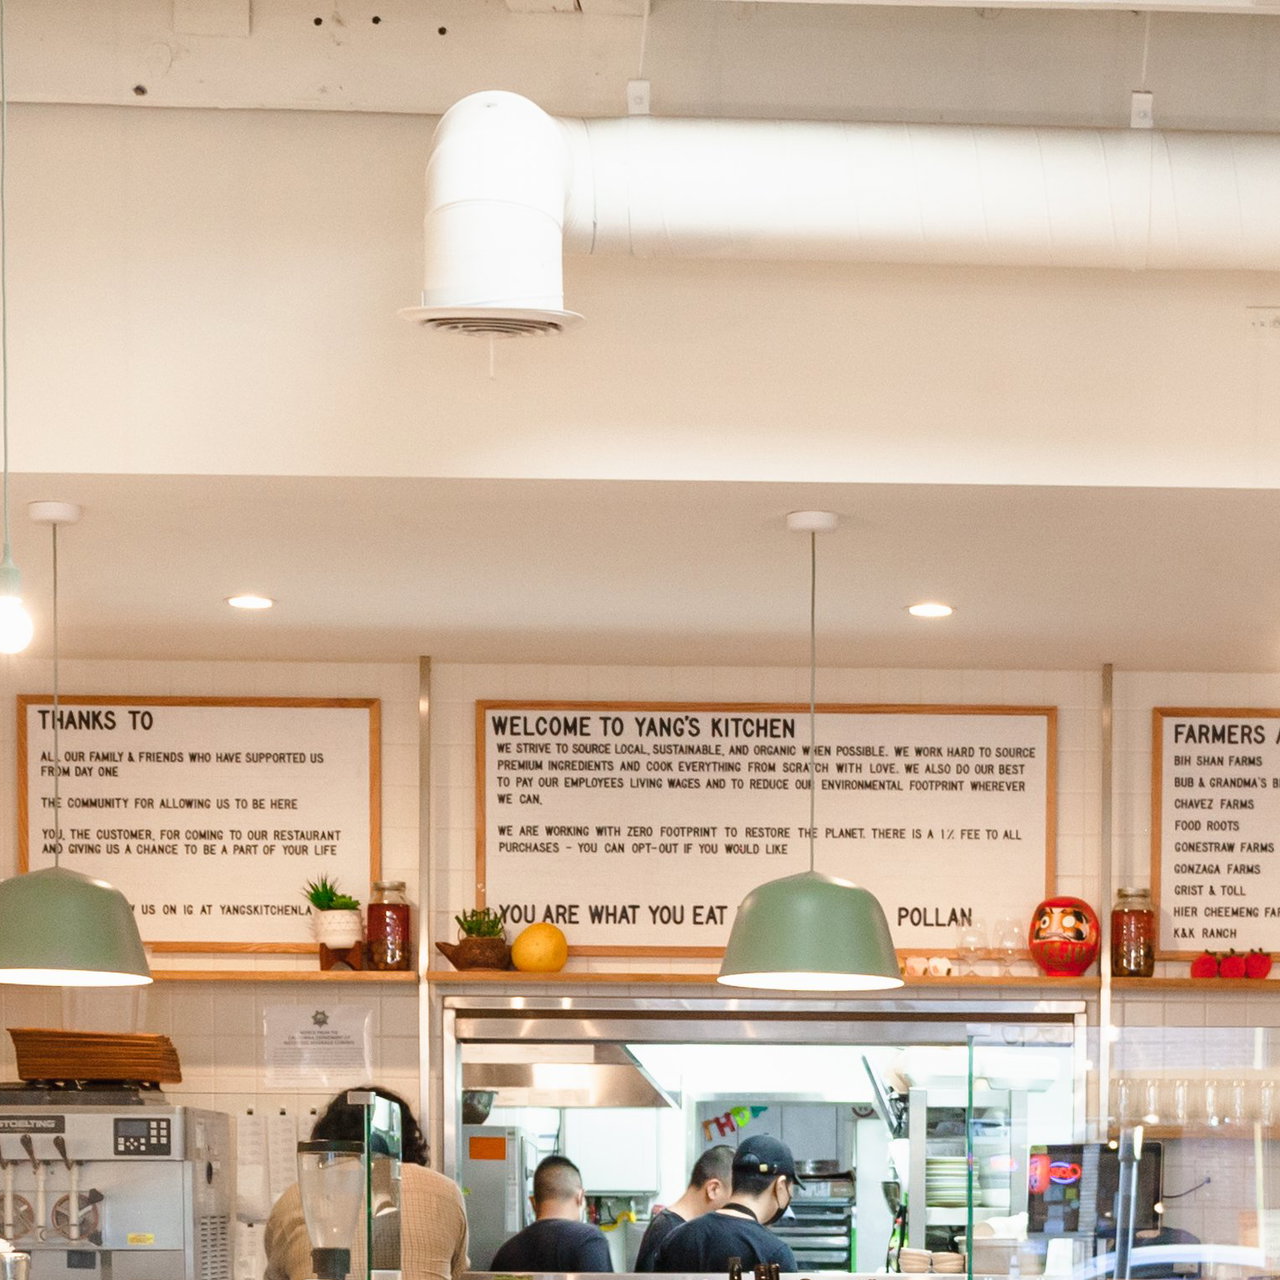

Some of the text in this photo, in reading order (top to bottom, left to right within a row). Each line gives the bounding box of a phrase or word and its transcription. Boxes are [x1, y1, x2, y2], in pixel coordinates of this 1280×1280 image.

[38, 710, 153, 730] THANKS TO
[492, 715, 794, 738] WELCOME TO YANG'S KITCHEN
[1174, 724, 1265, 744] FARMERS
[516, 742, 1035, 758] STRIVE SOURCE LOCAL, SUSTAINABLE, AND ORGANIC POSSIBLE. WORK HARD SOURCE
[64, 751, 306, 763] OUR FAMILY FRIENDS WHO HAVE SUPPORTED
[1174, 755, 1262, 766] BIH SHAN FARMS
[74, 766, 118, 777] DAY ONE
[497, 759, 1025, 775] PREMIUM INGREDIENTS AND COOK EVERYTHING FROM WITH LOVE. ALSO OUR BEST
[516, 776, 1025, 791] PAY OUR EMPLOYEES LIVING WAGES AND REDUCE ENVIRONMENTAL FOOTPRINT WHEREVER
[1174, 776, 1194, 787] BUB
[1209, 777, 1267, 788] GRANDMA'S
[67, 797, 297, 809] COMMUNITY FOR ALLOWING HERE
[1174, 798, 1254, 809] CHAVEZ FARMS
[1174, 819, 1239, 831] FOOD ROOTS
[70, 828, 341, 841] THE CUSTOMER, FOR COMING OUR RESTAURANT
[519, 825, 1021, 840] ARE WORKING WITH ZERO FOOTPRINT RESTORE PLANET. THERE FEE ALL
[68, 843, 337, 855] GIVING CHANCE PART YOUR LIFE
[498, 841, 788, 854] PURCHASES YOU CAN OPT-OUT YOU WOULD LIKE
[1174, 841, 1274, 852] GONESTRAW FARMS
[1174, 863, 1260, 874] GONZAGA FARMS
[1174, 884, 1246, 896] GRIST TOLL
[183, 903, 313, 915] IG AT YANGSKITCHENLA
[499, 904, 728, 925] YOU ARE WHAT YOU EAT
[1173, 906, 1197, 917] HIER
[1204, 906, 1259, 917] CHEEMENG
[897, 906, 971, 927] POLLAN
[1173, 927, 1236, 938] K&K RANCH
